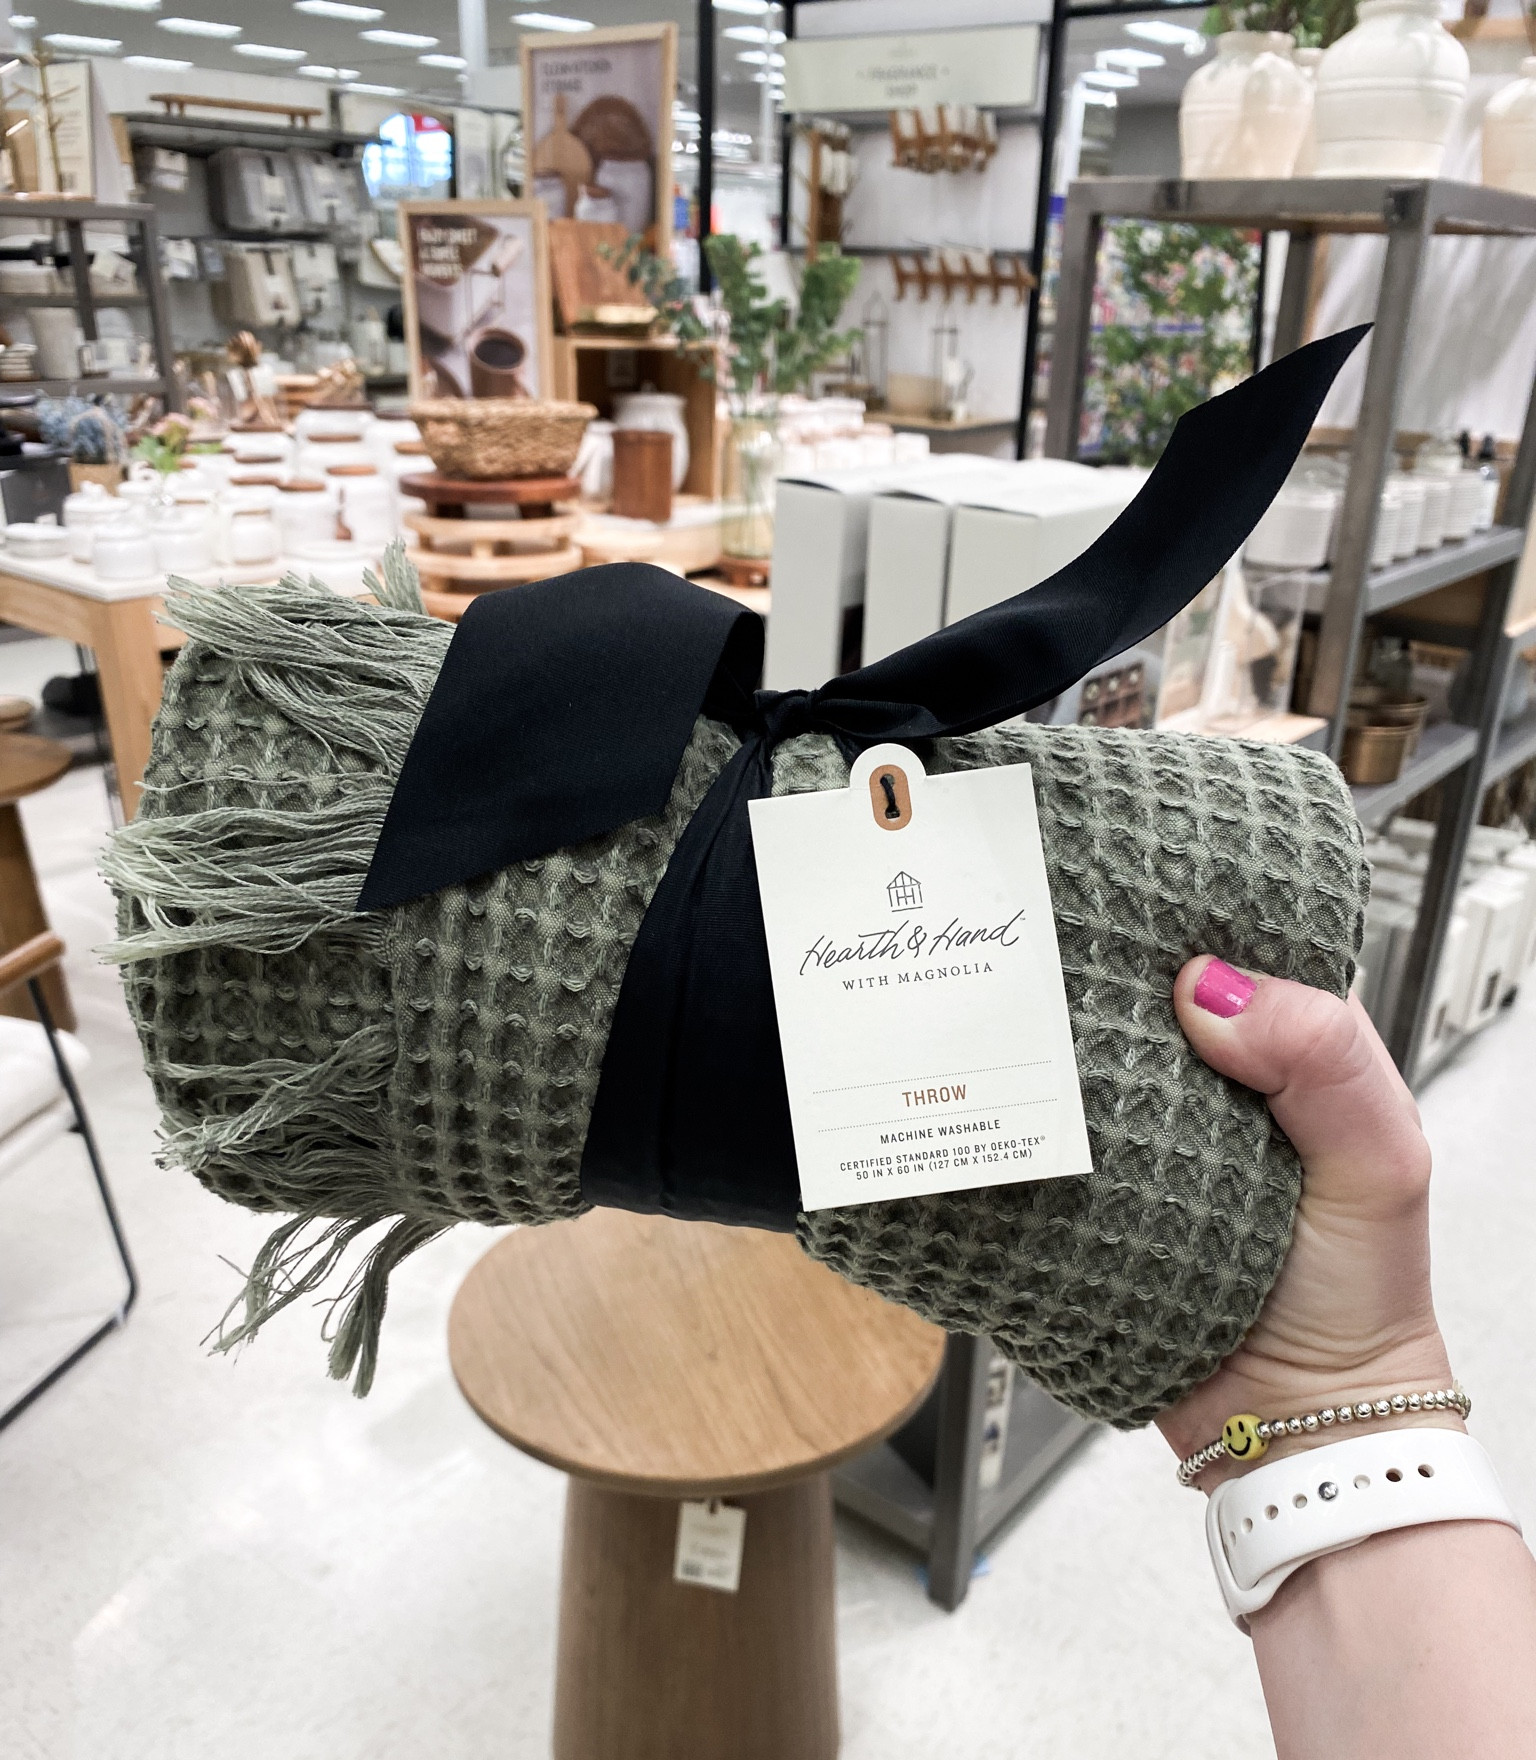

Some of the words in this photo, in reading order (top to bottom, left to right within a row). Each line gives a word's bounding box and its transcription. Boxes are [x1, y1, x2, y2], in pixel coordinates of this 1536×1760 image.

[799, 919, 910, 976] Hearth
[906, 925, 928, 959] &
[842, 975, 889, 991] WITH
[897, 962, 993, 984] MAGNOLIA
[901, 1084, 967, 1108] THROW
[880, 1127, 934, 1145] MACHINE
[937, 1119, 1001, 1137] WASHABLE
[839, 1156, 892, 1172] CERTIFIED
[895, 1148, 949, 1164] STANDARD
[952, 1145, 971, 1156] 100
[974, 1143, 987, 1154] BY
[856, 1170, 869, 1181] 50
[872, 1168, 883, 1178] IN
[886, 1167, 894, 1176] X
[896, 1164, 910, 1175] 60
[913, 1163, 925, 1173] IN
[928, 1159, 950, 1172] (127
[953, 1157, 969, 1168] CM
[972, 1155, 979, 1165] X
[982, 1151, 1009, 1164] 152.4
[1012, 1147, 1033, 1160] CM)
